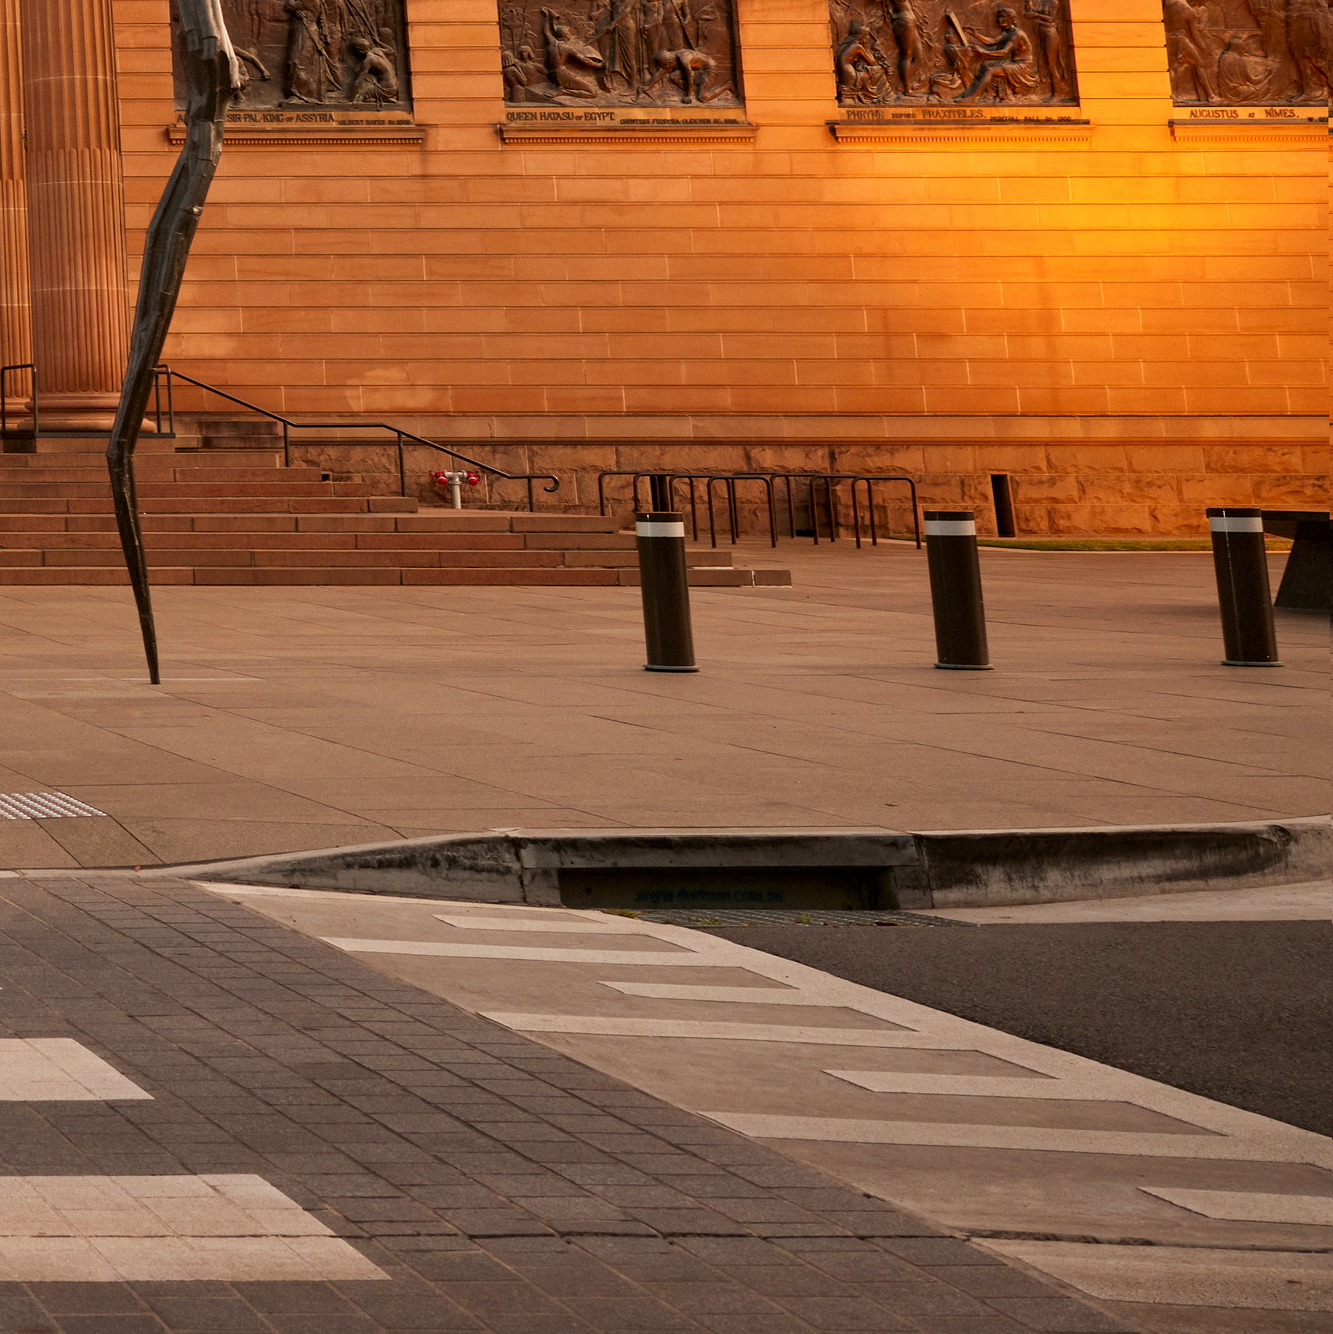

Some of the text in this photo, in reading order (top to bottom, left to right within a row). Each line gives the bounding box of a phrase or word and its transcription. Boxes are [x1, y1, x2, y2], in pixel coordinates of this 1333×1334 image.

[506, 111, 538, 122] QUEEN
[539, 111, 574, 121] HATASU
[846, 109, 885, 119] PHRYNE
[1189, 109, 1239, 118] AUGUSTUS
